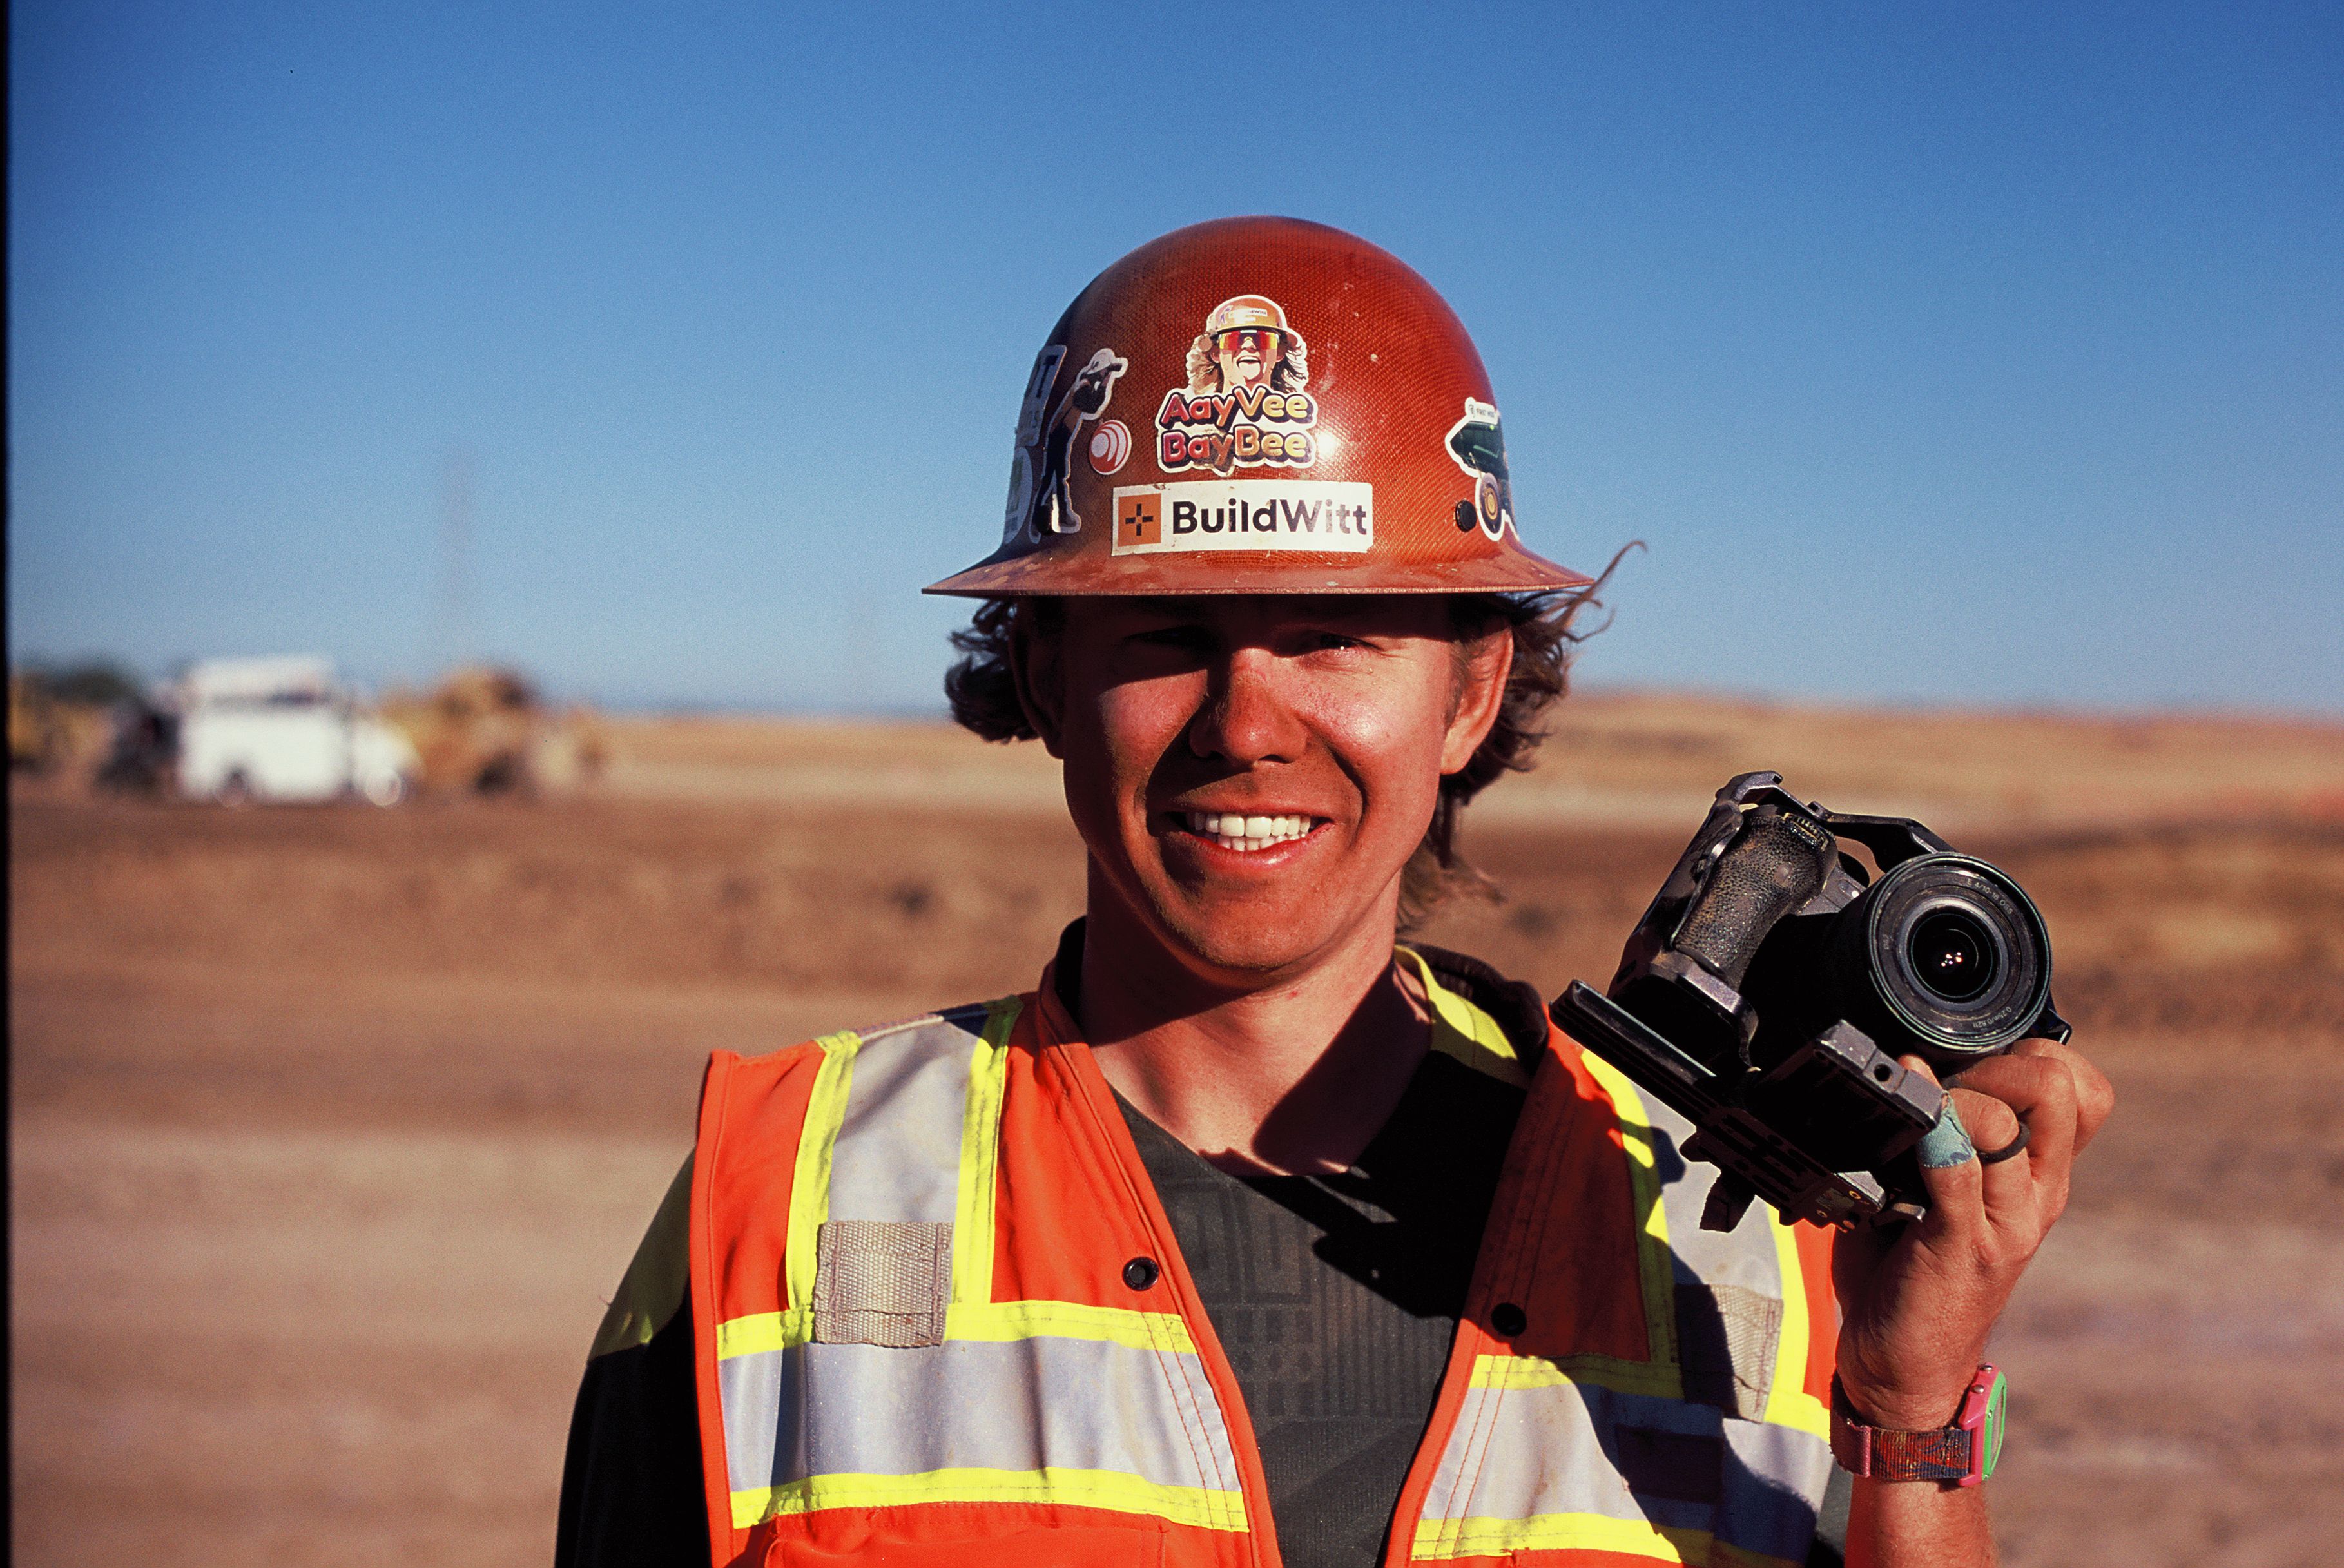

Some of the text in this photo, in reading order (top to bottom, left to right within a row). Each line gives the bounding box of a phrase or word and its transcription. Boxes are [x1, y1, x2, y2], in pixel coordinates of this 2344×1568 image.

[1160, 387, 1310, 428] AayVee
[1162, 427, 1308, 467] BayBee
[1173, 498, 1367, 536] BuildWitt
[1974, 882, 2000, 900] 4/10-18
[1999, 899, 2013, 915] OSS
